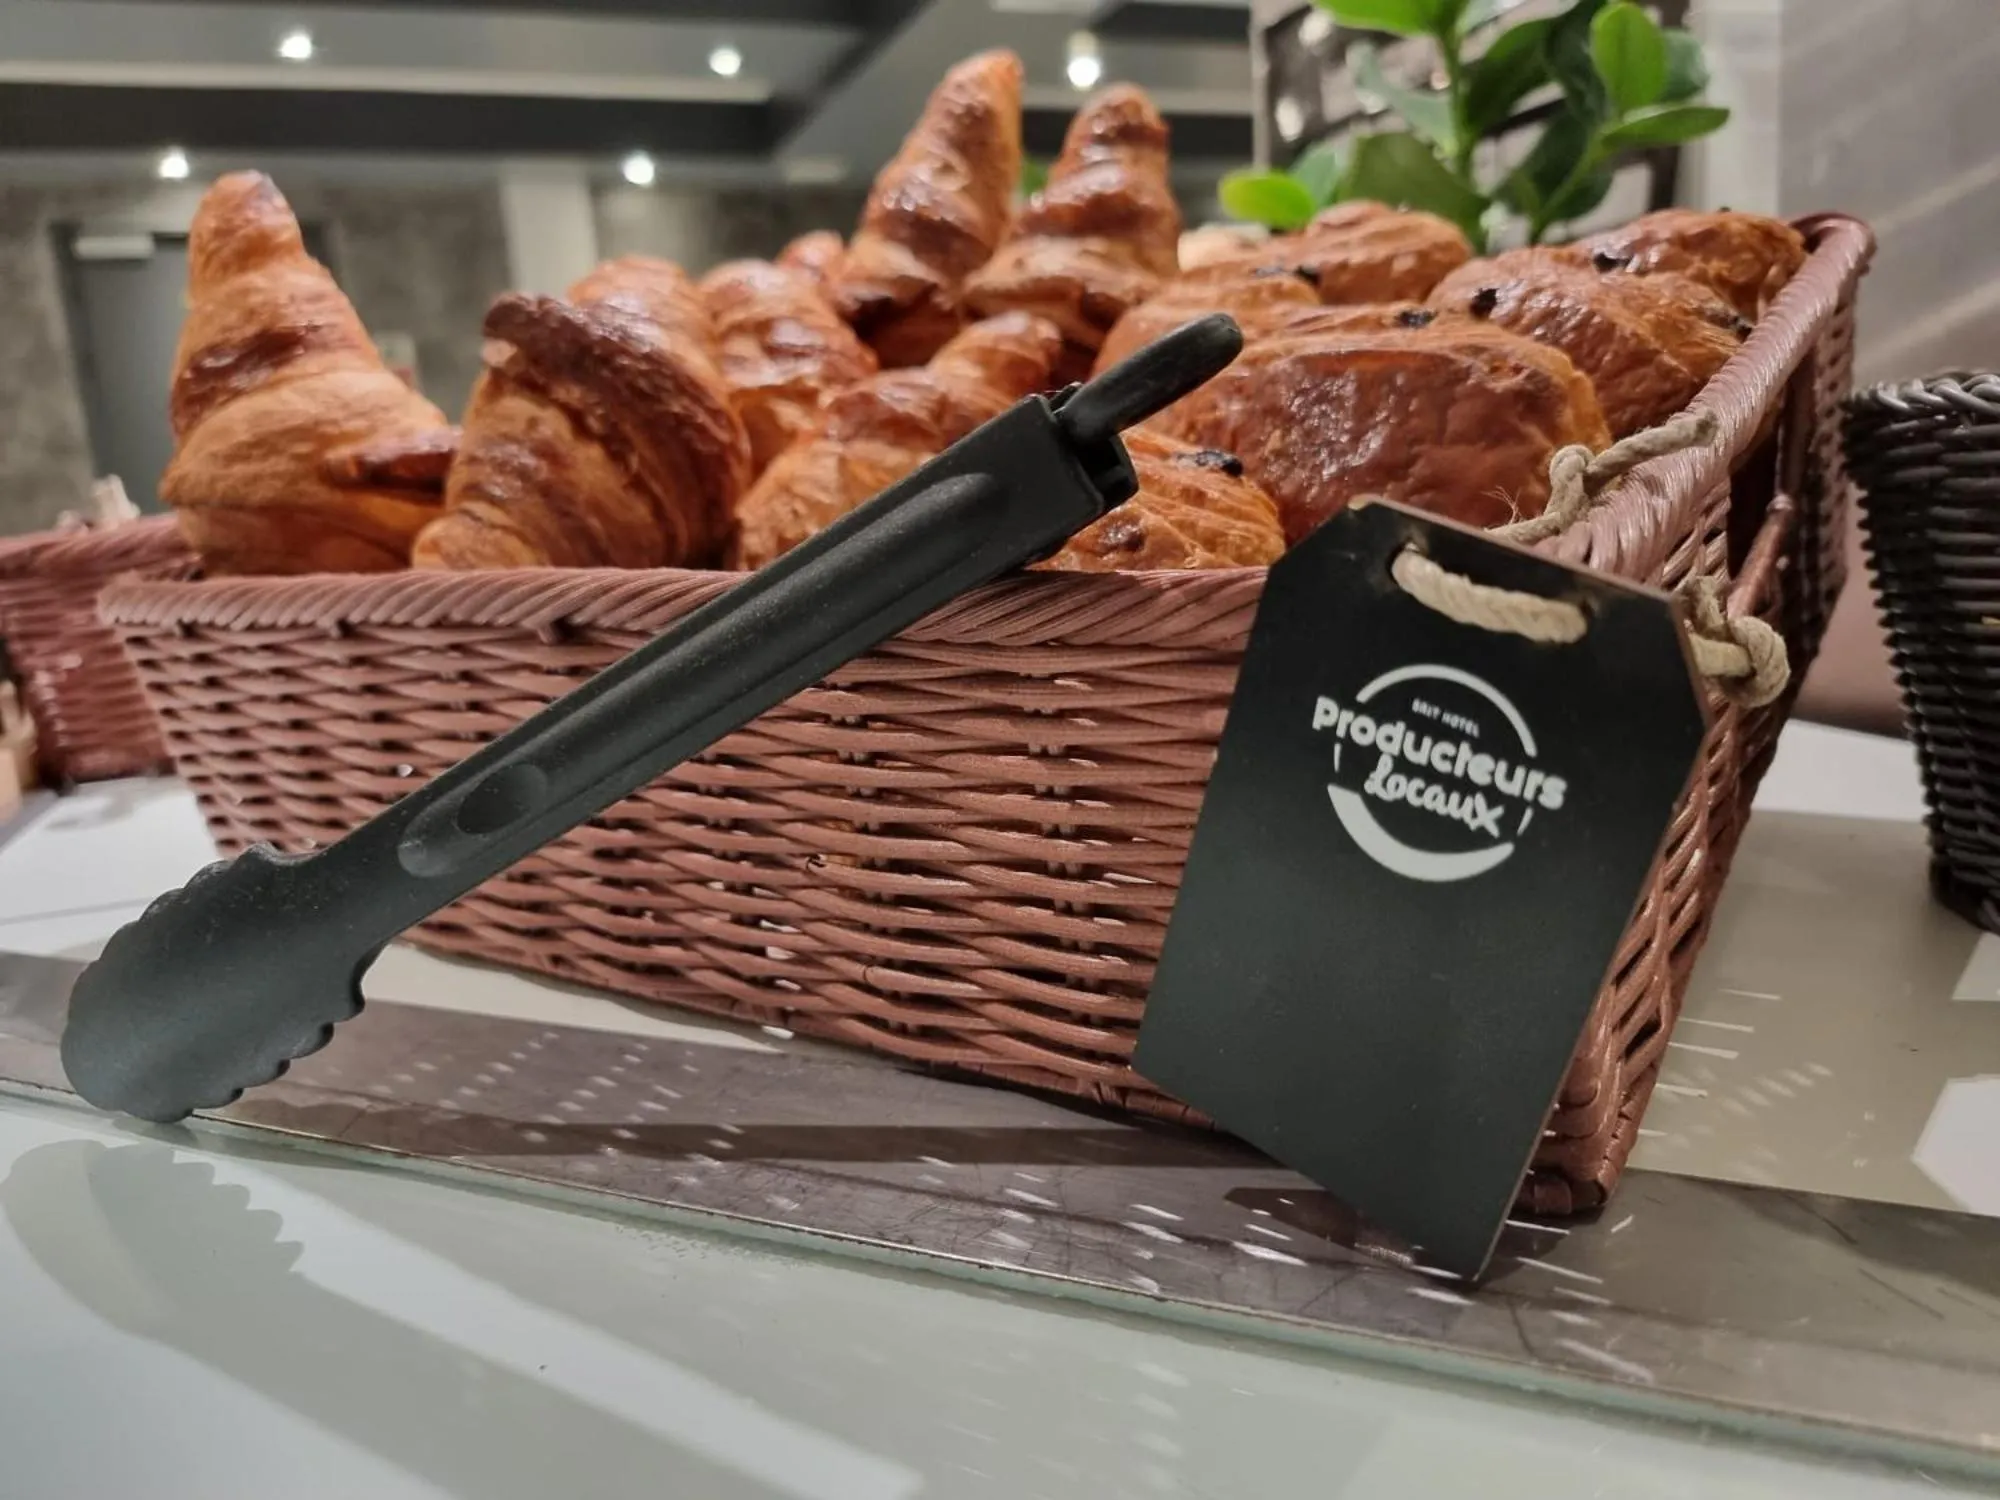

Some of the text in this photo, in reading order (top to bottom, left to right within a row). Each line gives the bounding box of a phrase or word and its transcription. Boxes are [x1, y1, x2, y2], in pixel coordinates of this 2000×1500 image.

[1312, 696, 1567, 810] Producteurs
[1441, 711, 1479, 738] HOTEL
[1364, 753, 1504, 838] Locaux
